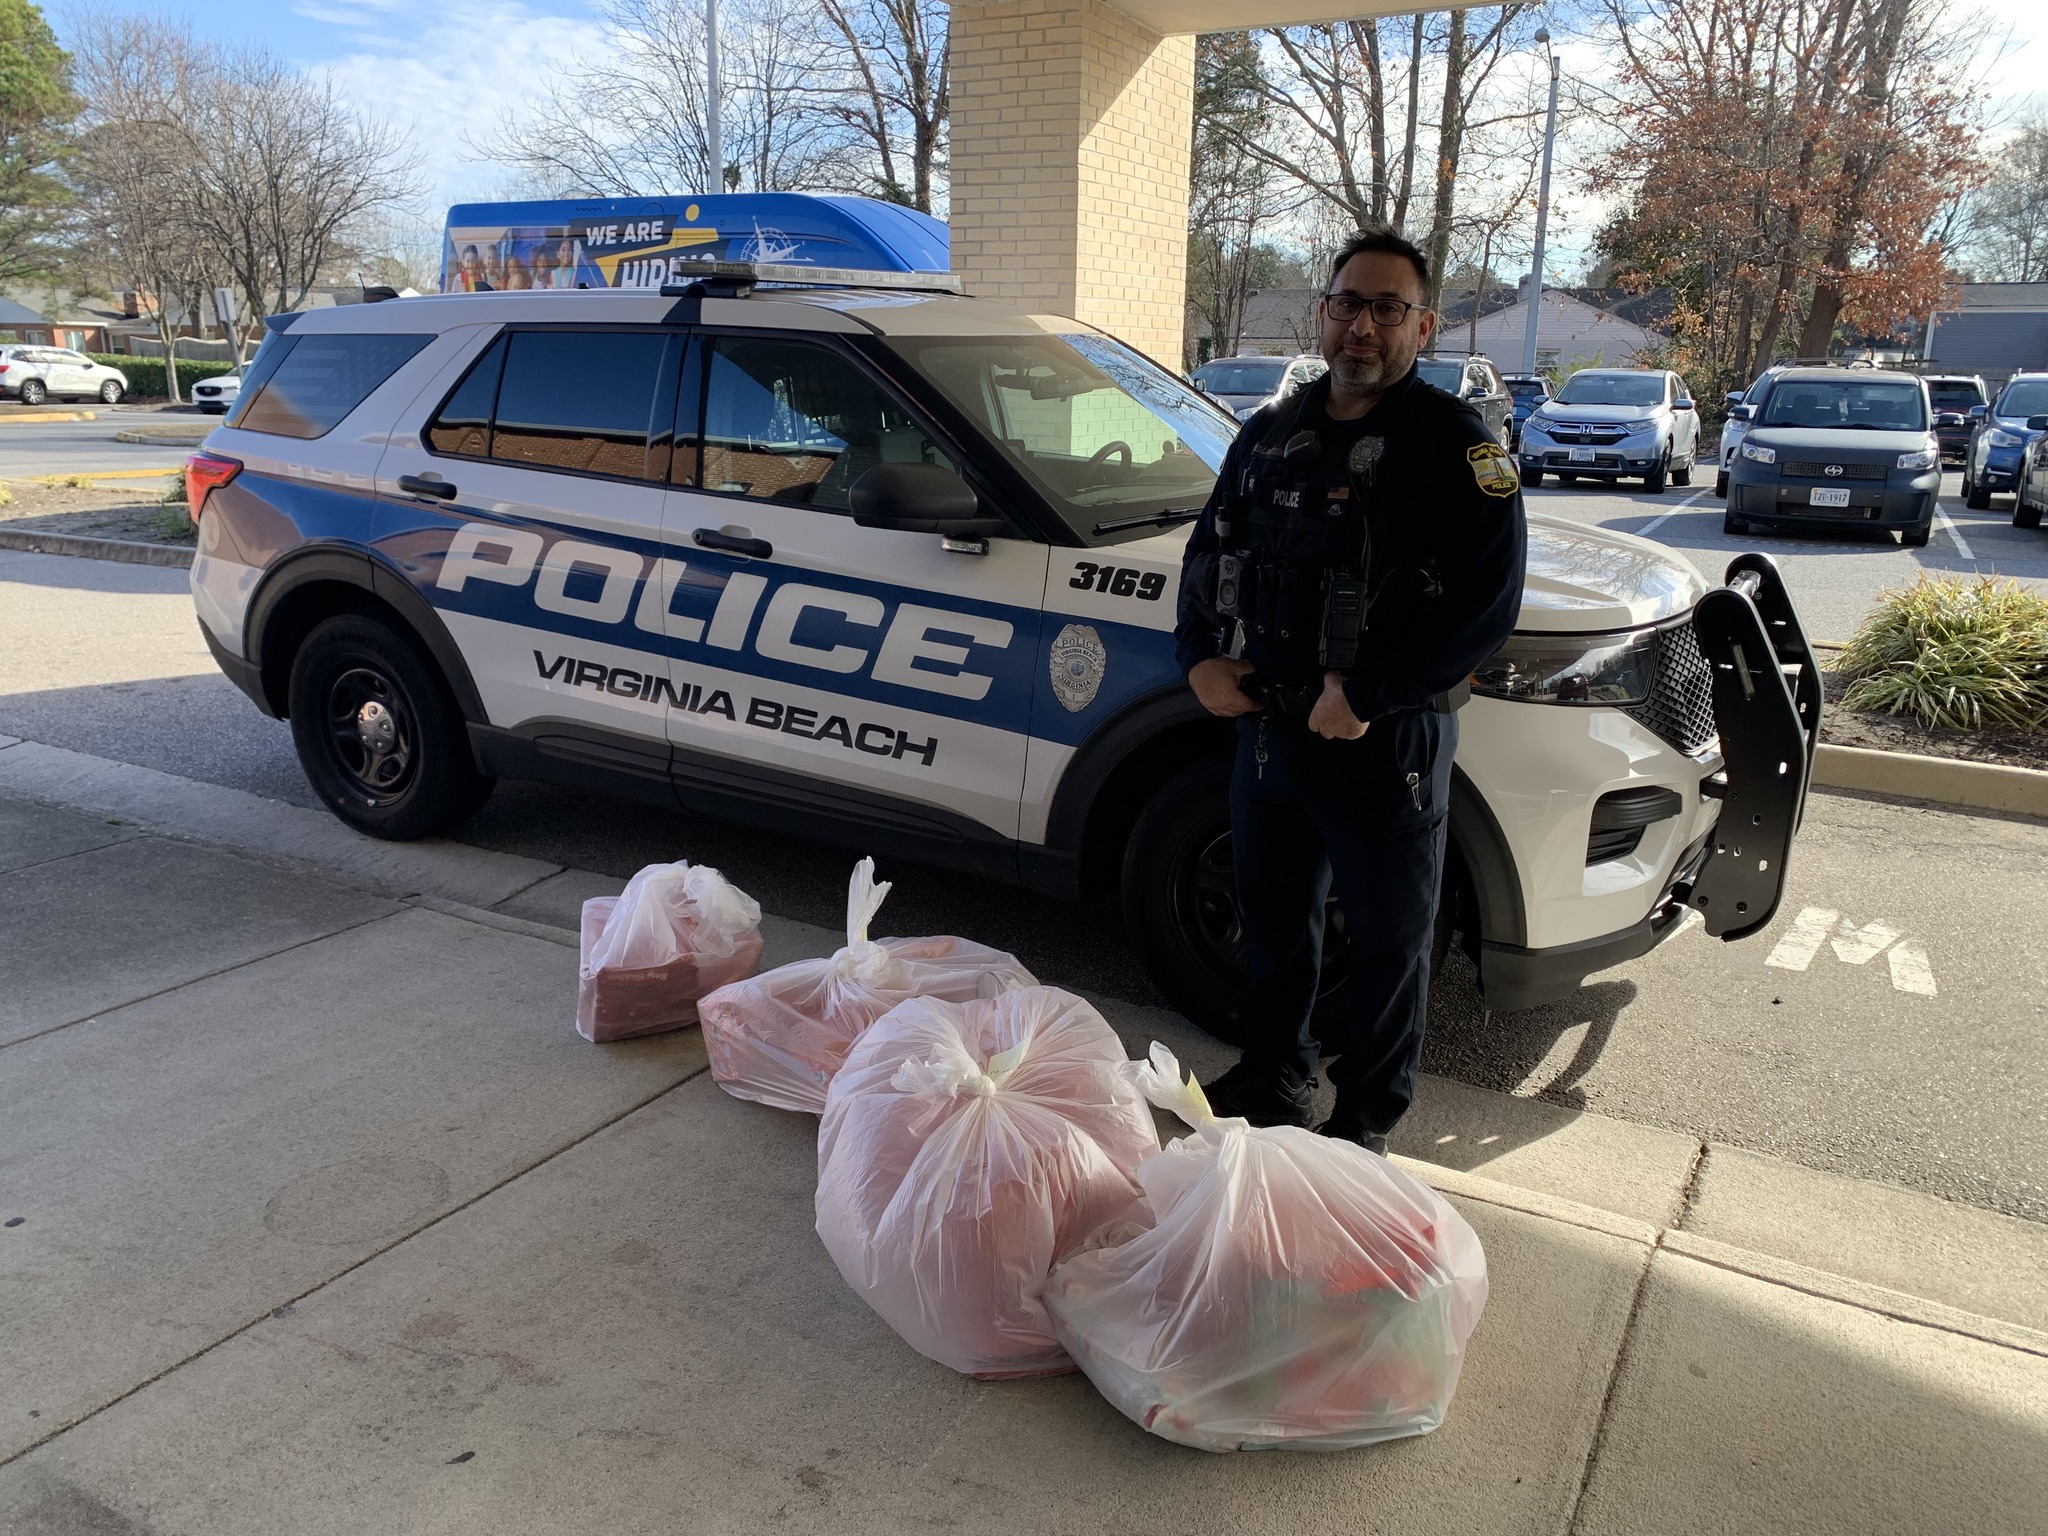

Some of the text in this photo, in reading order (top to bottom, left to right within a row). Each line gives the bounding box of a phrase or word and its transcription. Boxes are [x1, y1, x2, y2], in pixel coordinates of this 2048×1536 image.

[586, 220, 664, 246] WE ARE
[1492, 481, 1512, 490] POLICE
[1273, 489, 1300, 508] POLICE
[1069, 561, 1167, 601] 3169
[435, 522, 1015, 701] POLICE
[1062, 638, 1099, 653] POLICE
[1060, 648, 1098, 663] VIRGINIA BEACH
[1061, 673, 1091, 688] VIRGINIA
[532, 650, 938, 767] VIRGINIA BEACH
